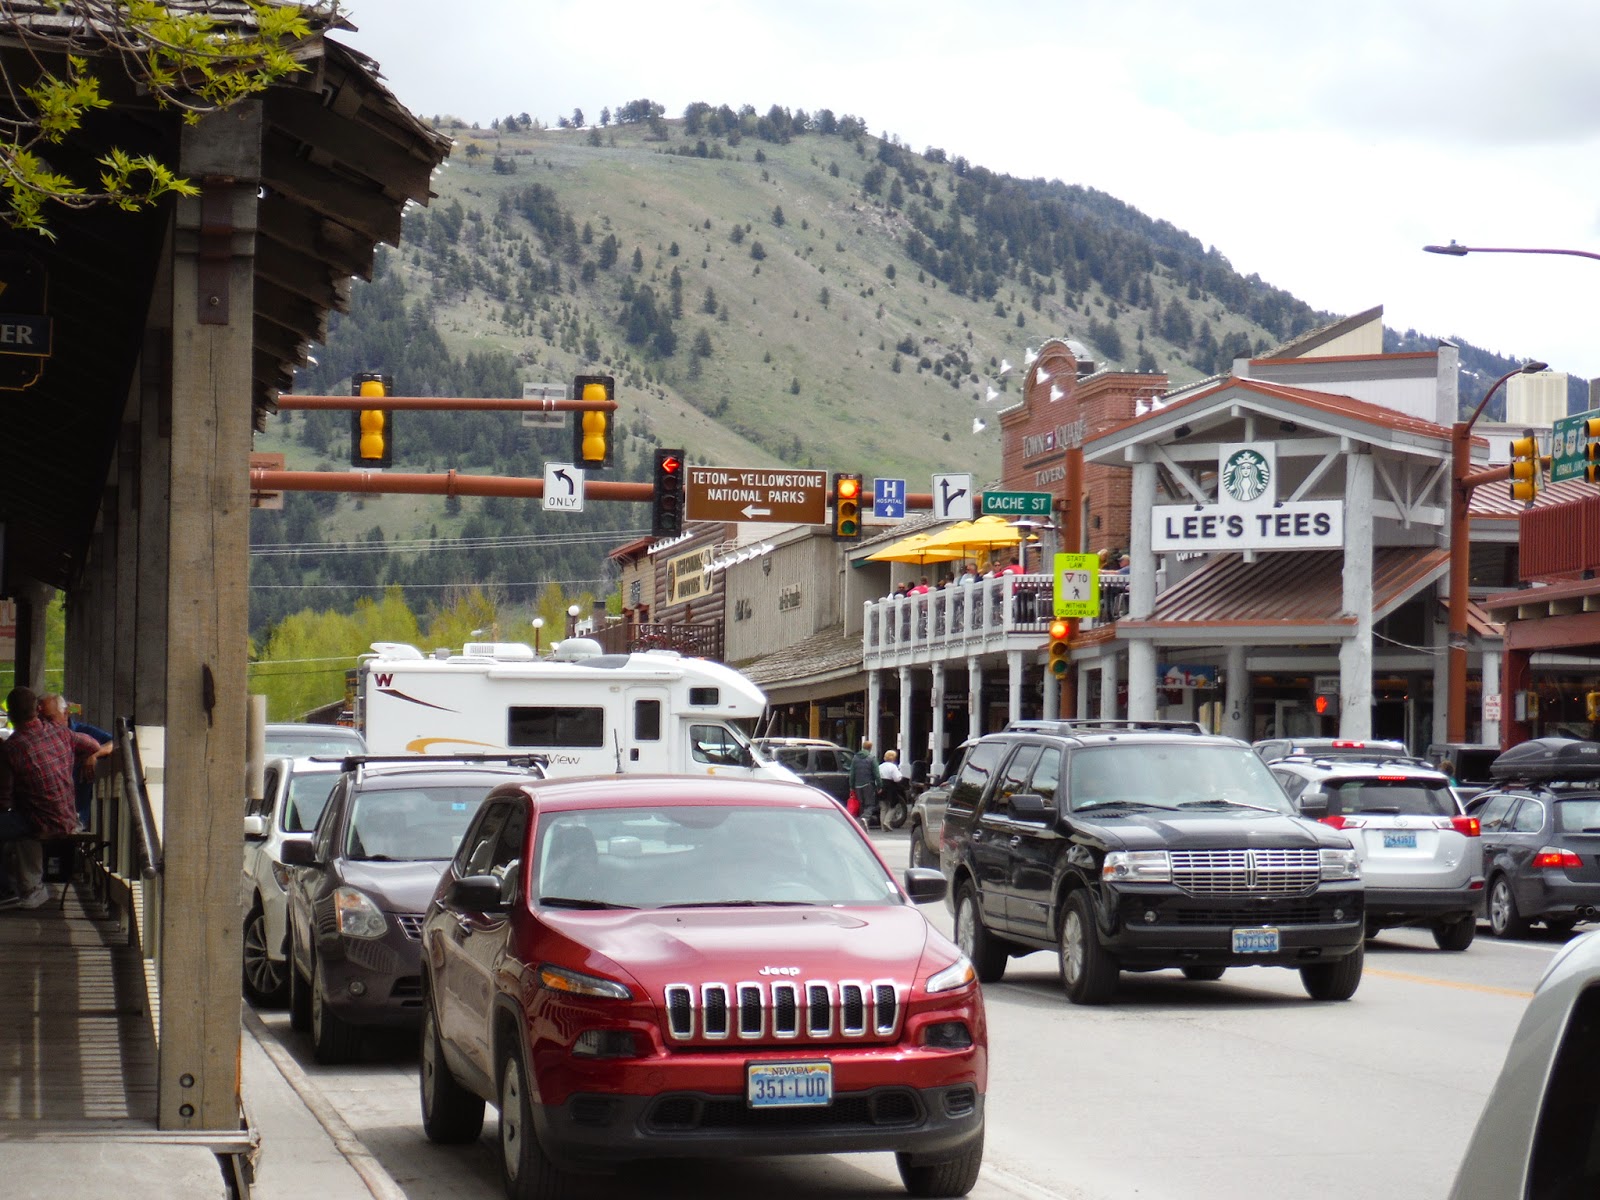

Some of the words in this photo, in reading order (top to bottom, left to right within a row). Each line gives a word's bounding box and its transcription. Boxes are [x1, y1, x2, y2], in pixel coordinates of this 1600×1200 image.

[1022, 433, 1044, 459] TOWN
[883, 481, 896, 498] H
[549, 496, 577, 507] ONLY
[707, 488, 762, 502] NATIONAL
[768, 490, 805, 504] PARKS
[987, 496, 1025, 510] CACHE
[1031, 498, 1047, 510] ST
[1165, 514, 1244, 540] LEE'S
[1255, 512, 1331, 538] TEES
[1078, 573, 1088, 583] TO
[1056, 608, 1096, 616] CROSSWALK
[373, 673, 394, 687] W
[547, 753, 581, 764] View
[758, 966, 800, 976] Jeep
[771, 1066, 810, 1076] NEVADA
